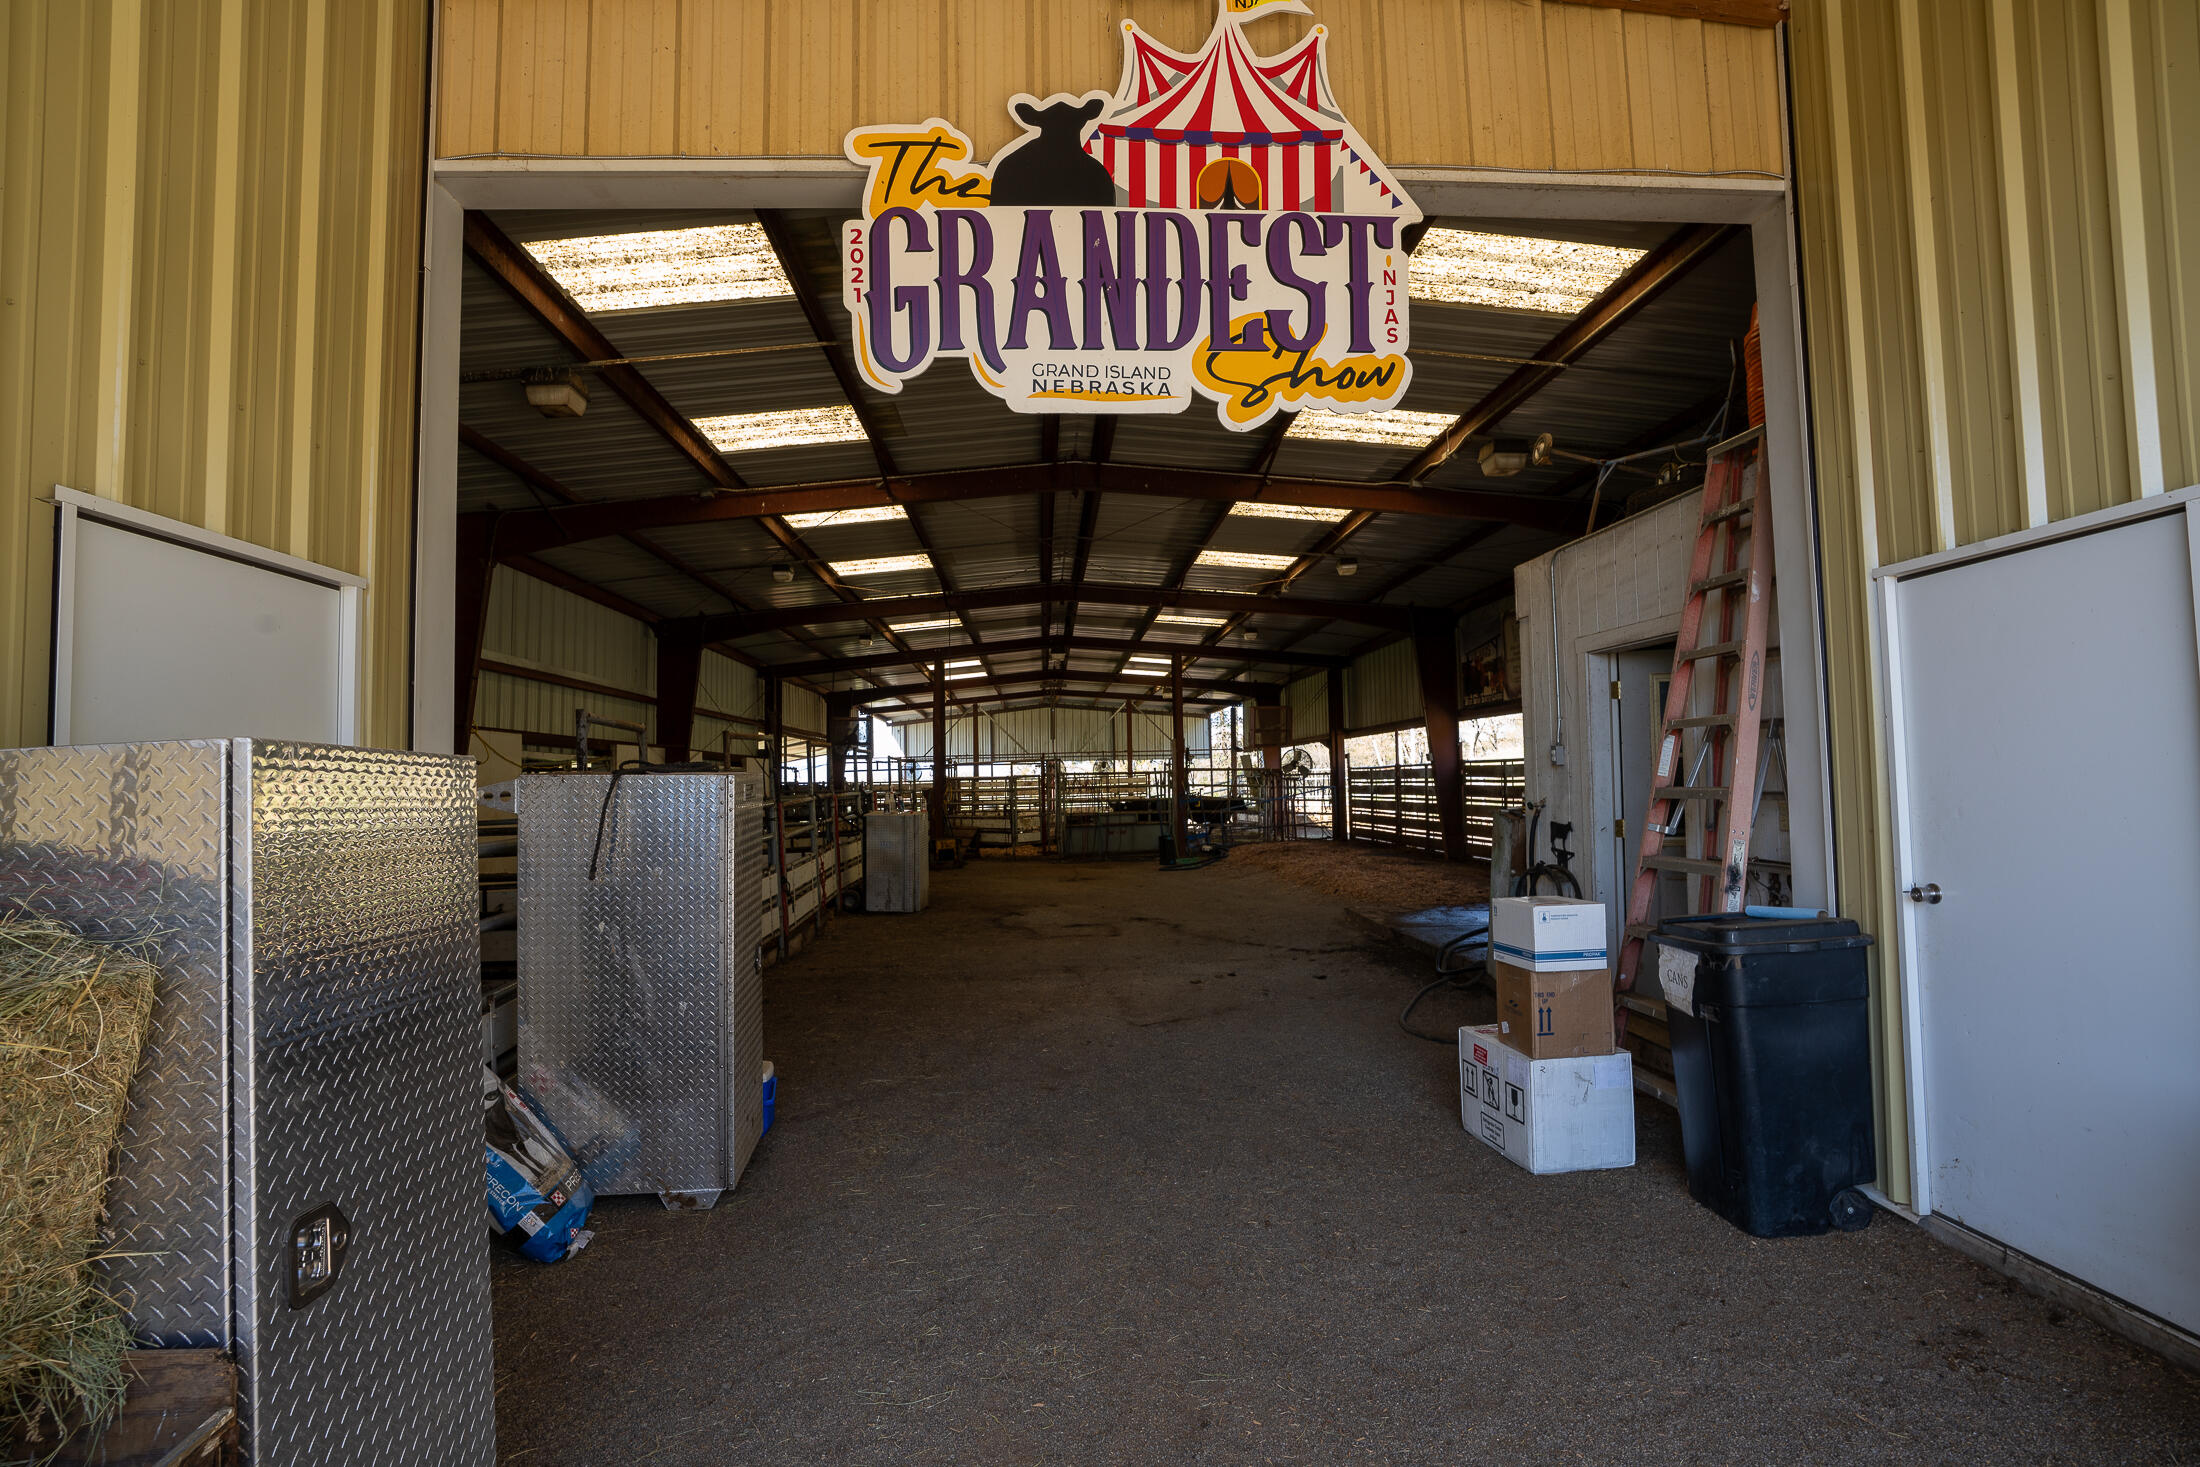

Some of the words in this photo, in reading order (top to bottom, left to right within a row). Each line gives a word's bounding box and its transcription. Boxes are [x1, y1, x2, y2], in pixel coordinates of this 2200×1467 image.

[868, 136, 991, 204] The
[850, 229, 864, 303] 2021
[864, 207, 1400, 373] GRANDEST
[1383, 269, 1399, 344] NJAS
[1032, 363, 1099, 378] GRAND
[1105, 365, 1171, 380] ISLAND
[1032, 379, 1172, 396] NEBRASKA
[1206, 328, 1396, 408] Show
[1667, 969, 1688, 989] CANS
